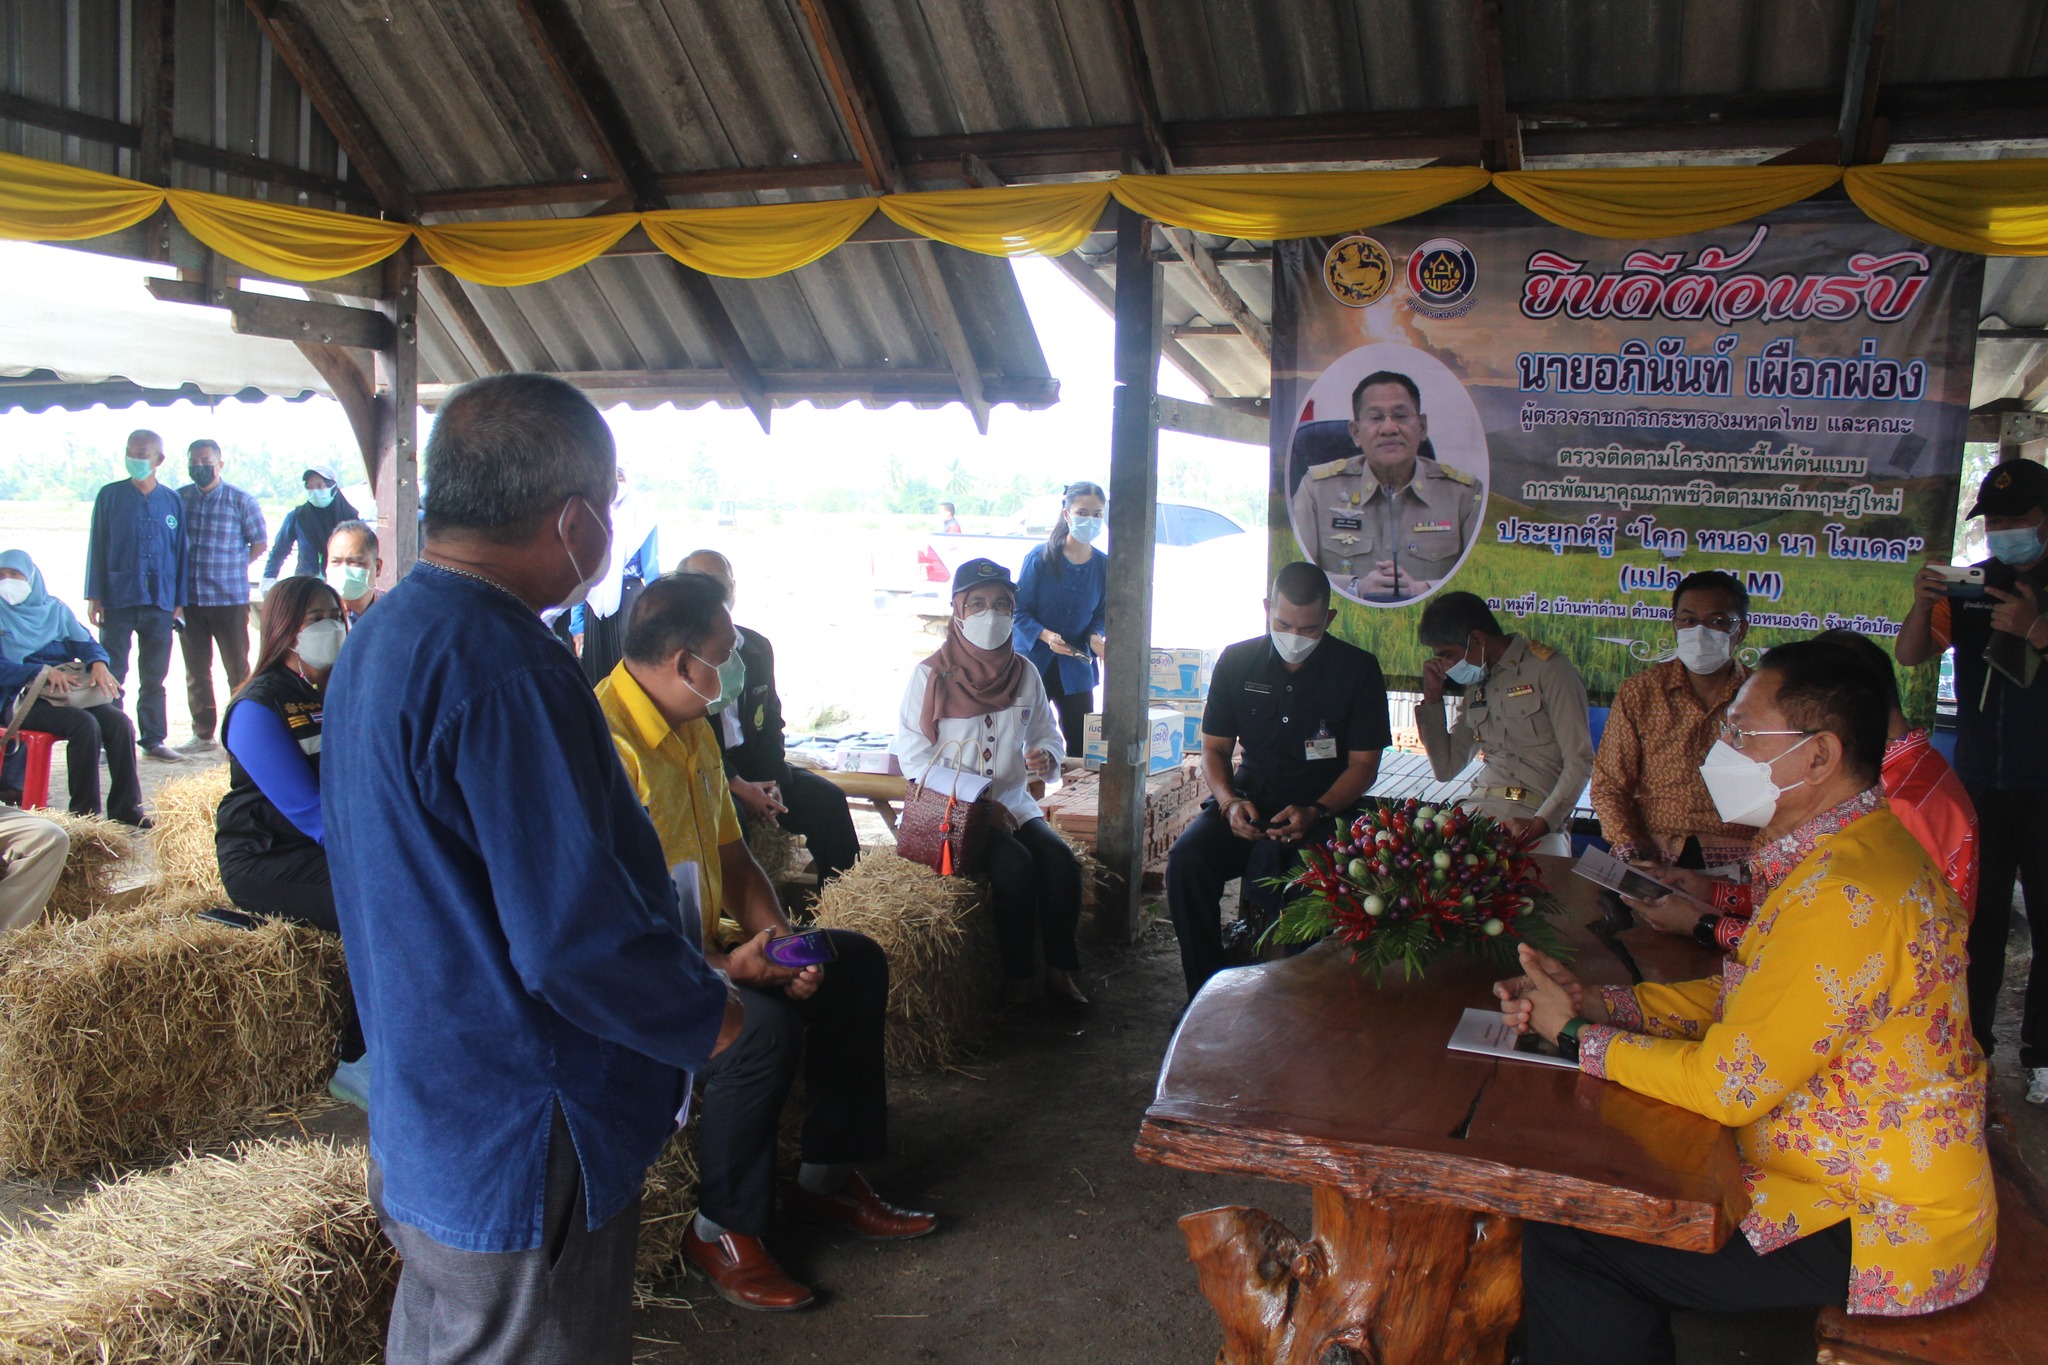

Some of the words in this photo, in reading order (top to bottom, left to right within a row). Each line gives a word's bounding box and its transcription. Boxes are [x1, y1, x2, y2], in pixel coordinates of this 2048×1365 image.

[1523, 226, 1930, 323] ยินดีต้อนรับ
[1519, 337, 1738, 394] นายอภินันท์
[1748, 339, 1927, 399] เผือกผ่อง
[1521, 402, 1817, 431] ผู้ตรวจราชการกระทรวงมหาดไทย
[1827, 416, 1913, 433] และคณะ
[1559, 443, 1866, 474] ตรวจติดตามโครงการพื้นที่ต้นแบบ
[1525, 479, 1901, 516] การพัฒนาคุณภาพชีวิตตามหลักทฤษฎีใหม่
[1498, 516, 1615, 557] ประยุกต์สู่
[1698, 530, 1768, 554] หนอง
[1779, 534, 1815, 557] นา
[1619, 565, 1697, 593] (แปล
[1487, 598, 1500, 609] ณ
[1506, 593, 1535, 617] หมู่ที่
[1540, 600, 1549, 612] 2
[1554, 597, 1626, 617] บ้านท่าด่าน
[1632, 601, 1676, 620] ตำบลด
[1824, 614, 1902, 635] จังหวัดปัตต
